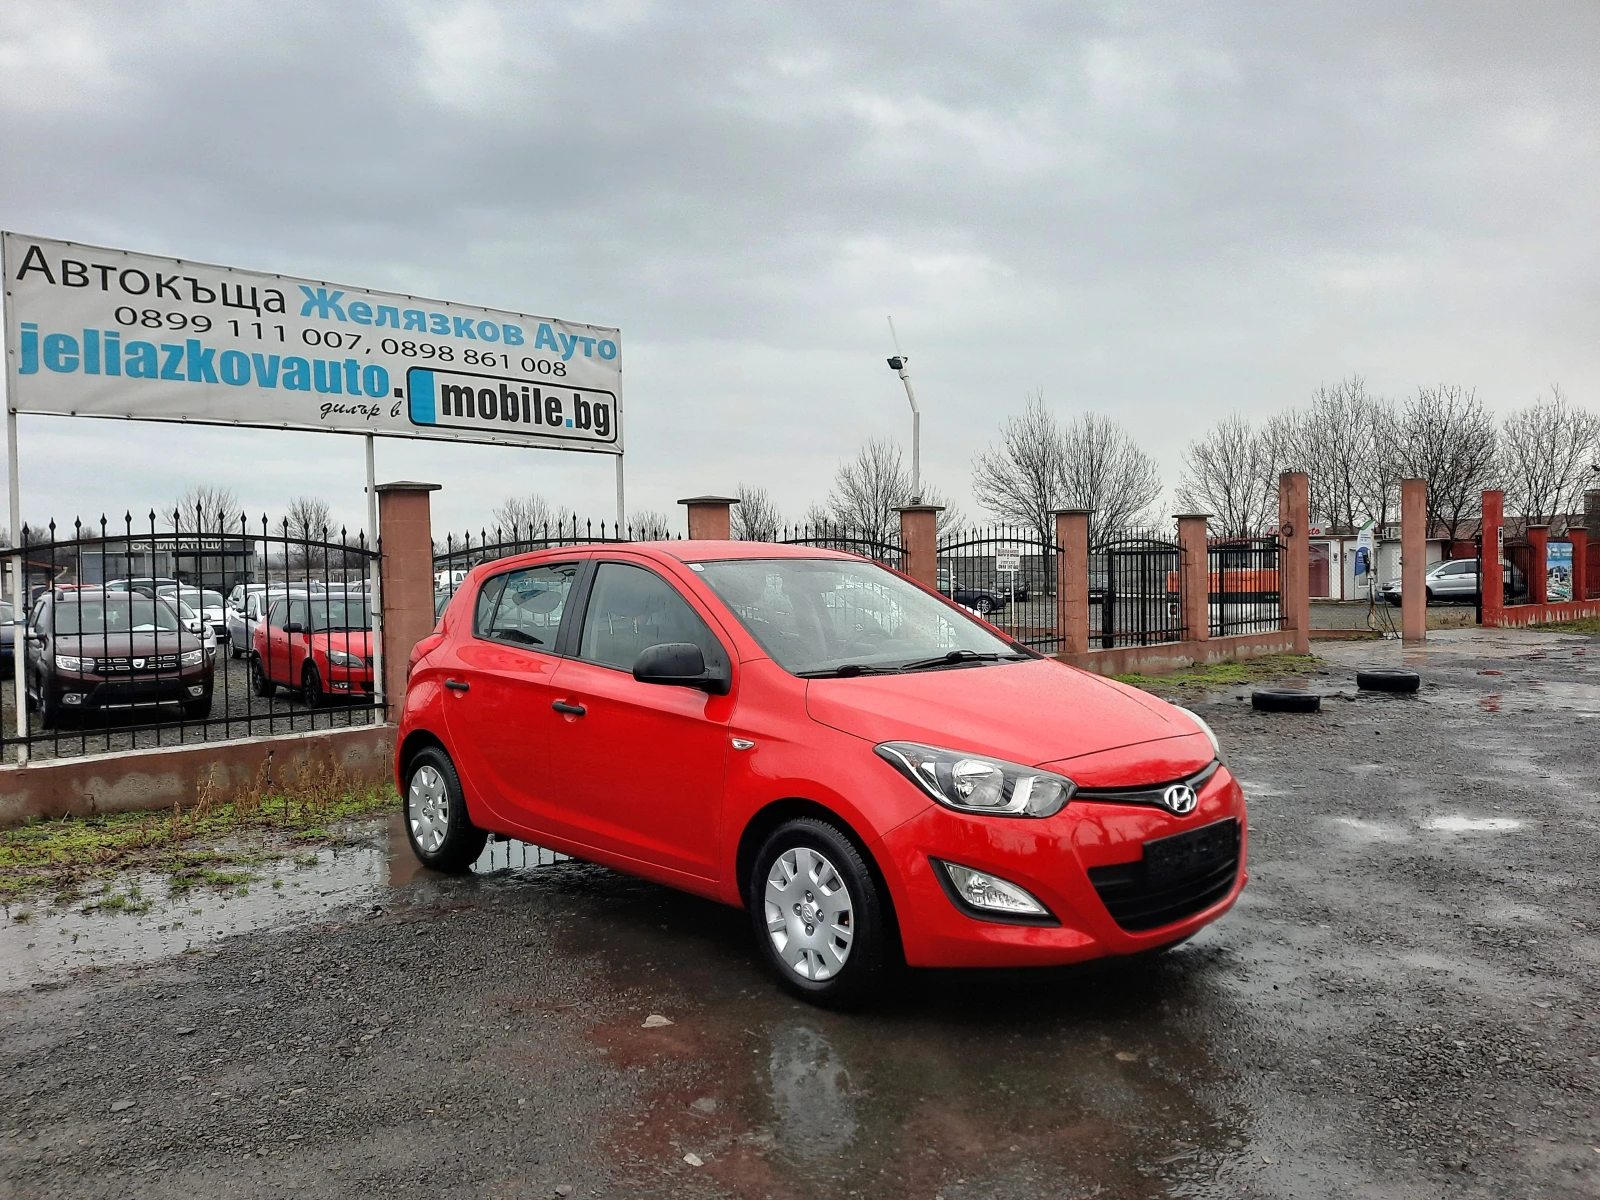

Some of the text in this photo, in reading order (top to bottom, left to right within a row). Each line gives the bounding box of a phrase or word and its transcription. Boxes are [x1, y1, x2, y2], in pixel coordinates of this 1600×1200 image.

[16, 245, 617, 360] Автокъща Желязков Ауто
[114, 306, 567, 377] 0899 111 007, 0898 861 008
[320, 401, 381, 420] дилър
[441, 383, 610, 436] mobile.bg
